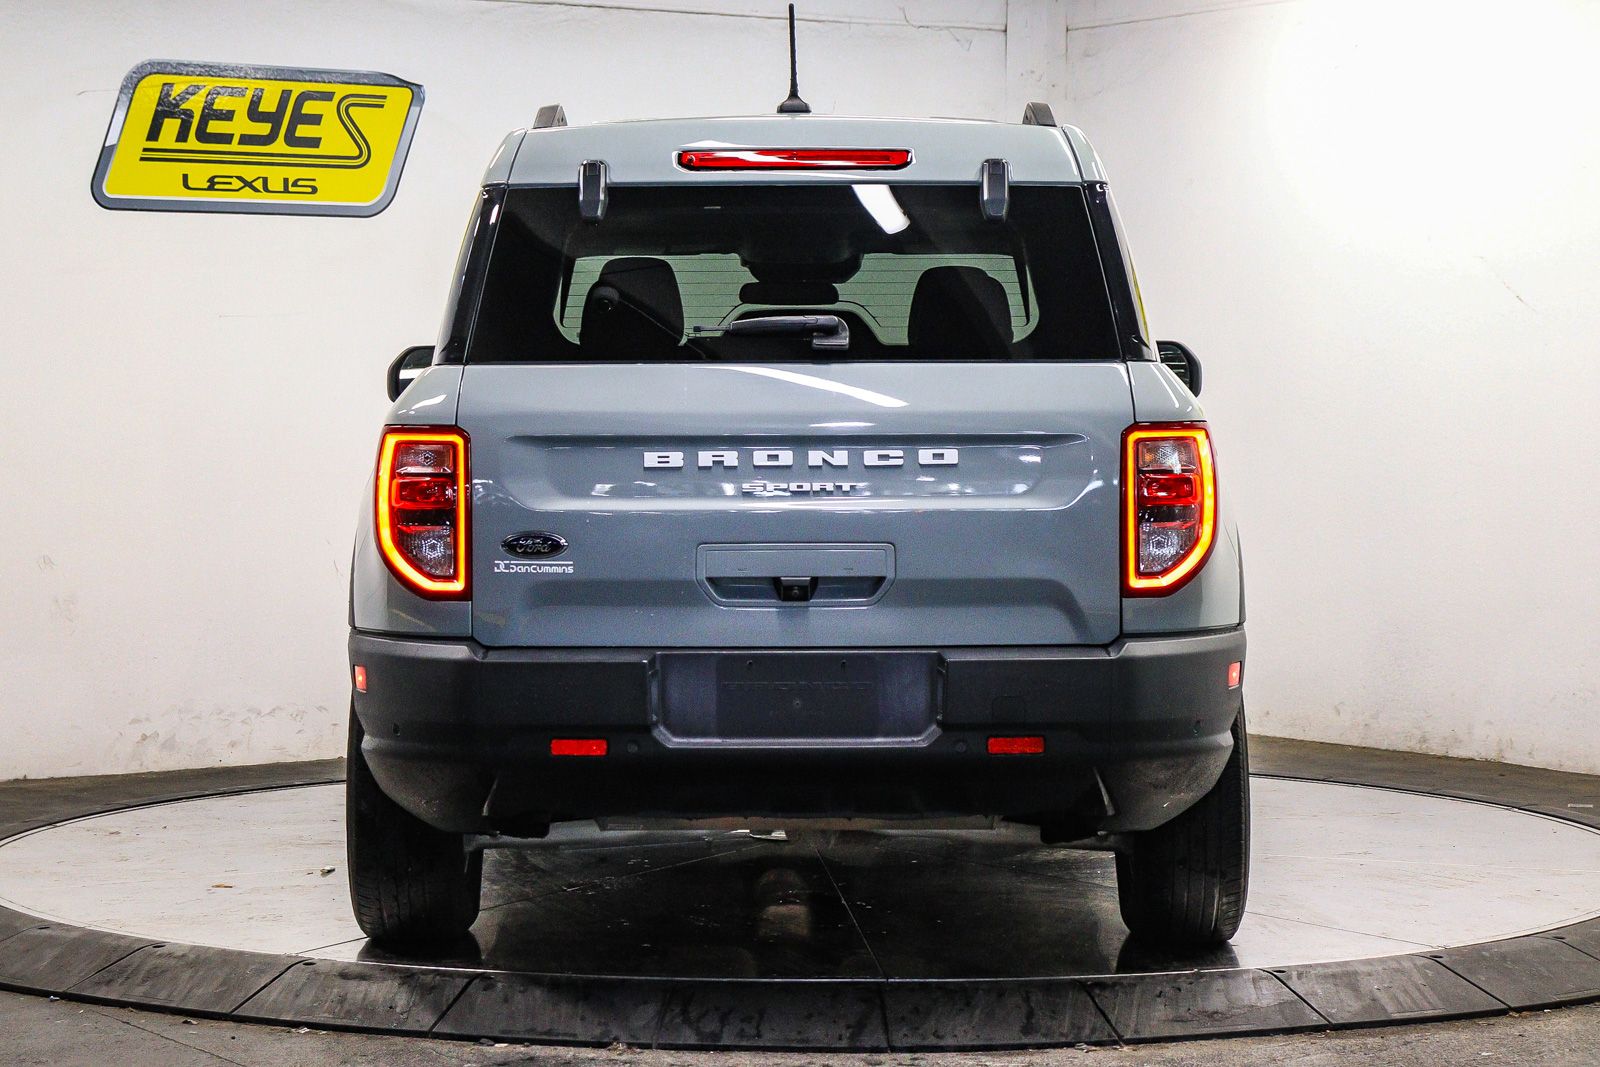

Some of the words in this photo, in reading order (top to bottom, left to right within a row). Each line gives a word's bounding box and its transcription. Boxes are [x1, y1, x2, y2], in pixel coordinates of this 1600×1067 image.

[140, 82, 387, 169] KEYES
[182, 173, 318, 195] LEXUS
[643, 448, 959, 468] BRONCO
[741, 482, 857, 492] SPORT
